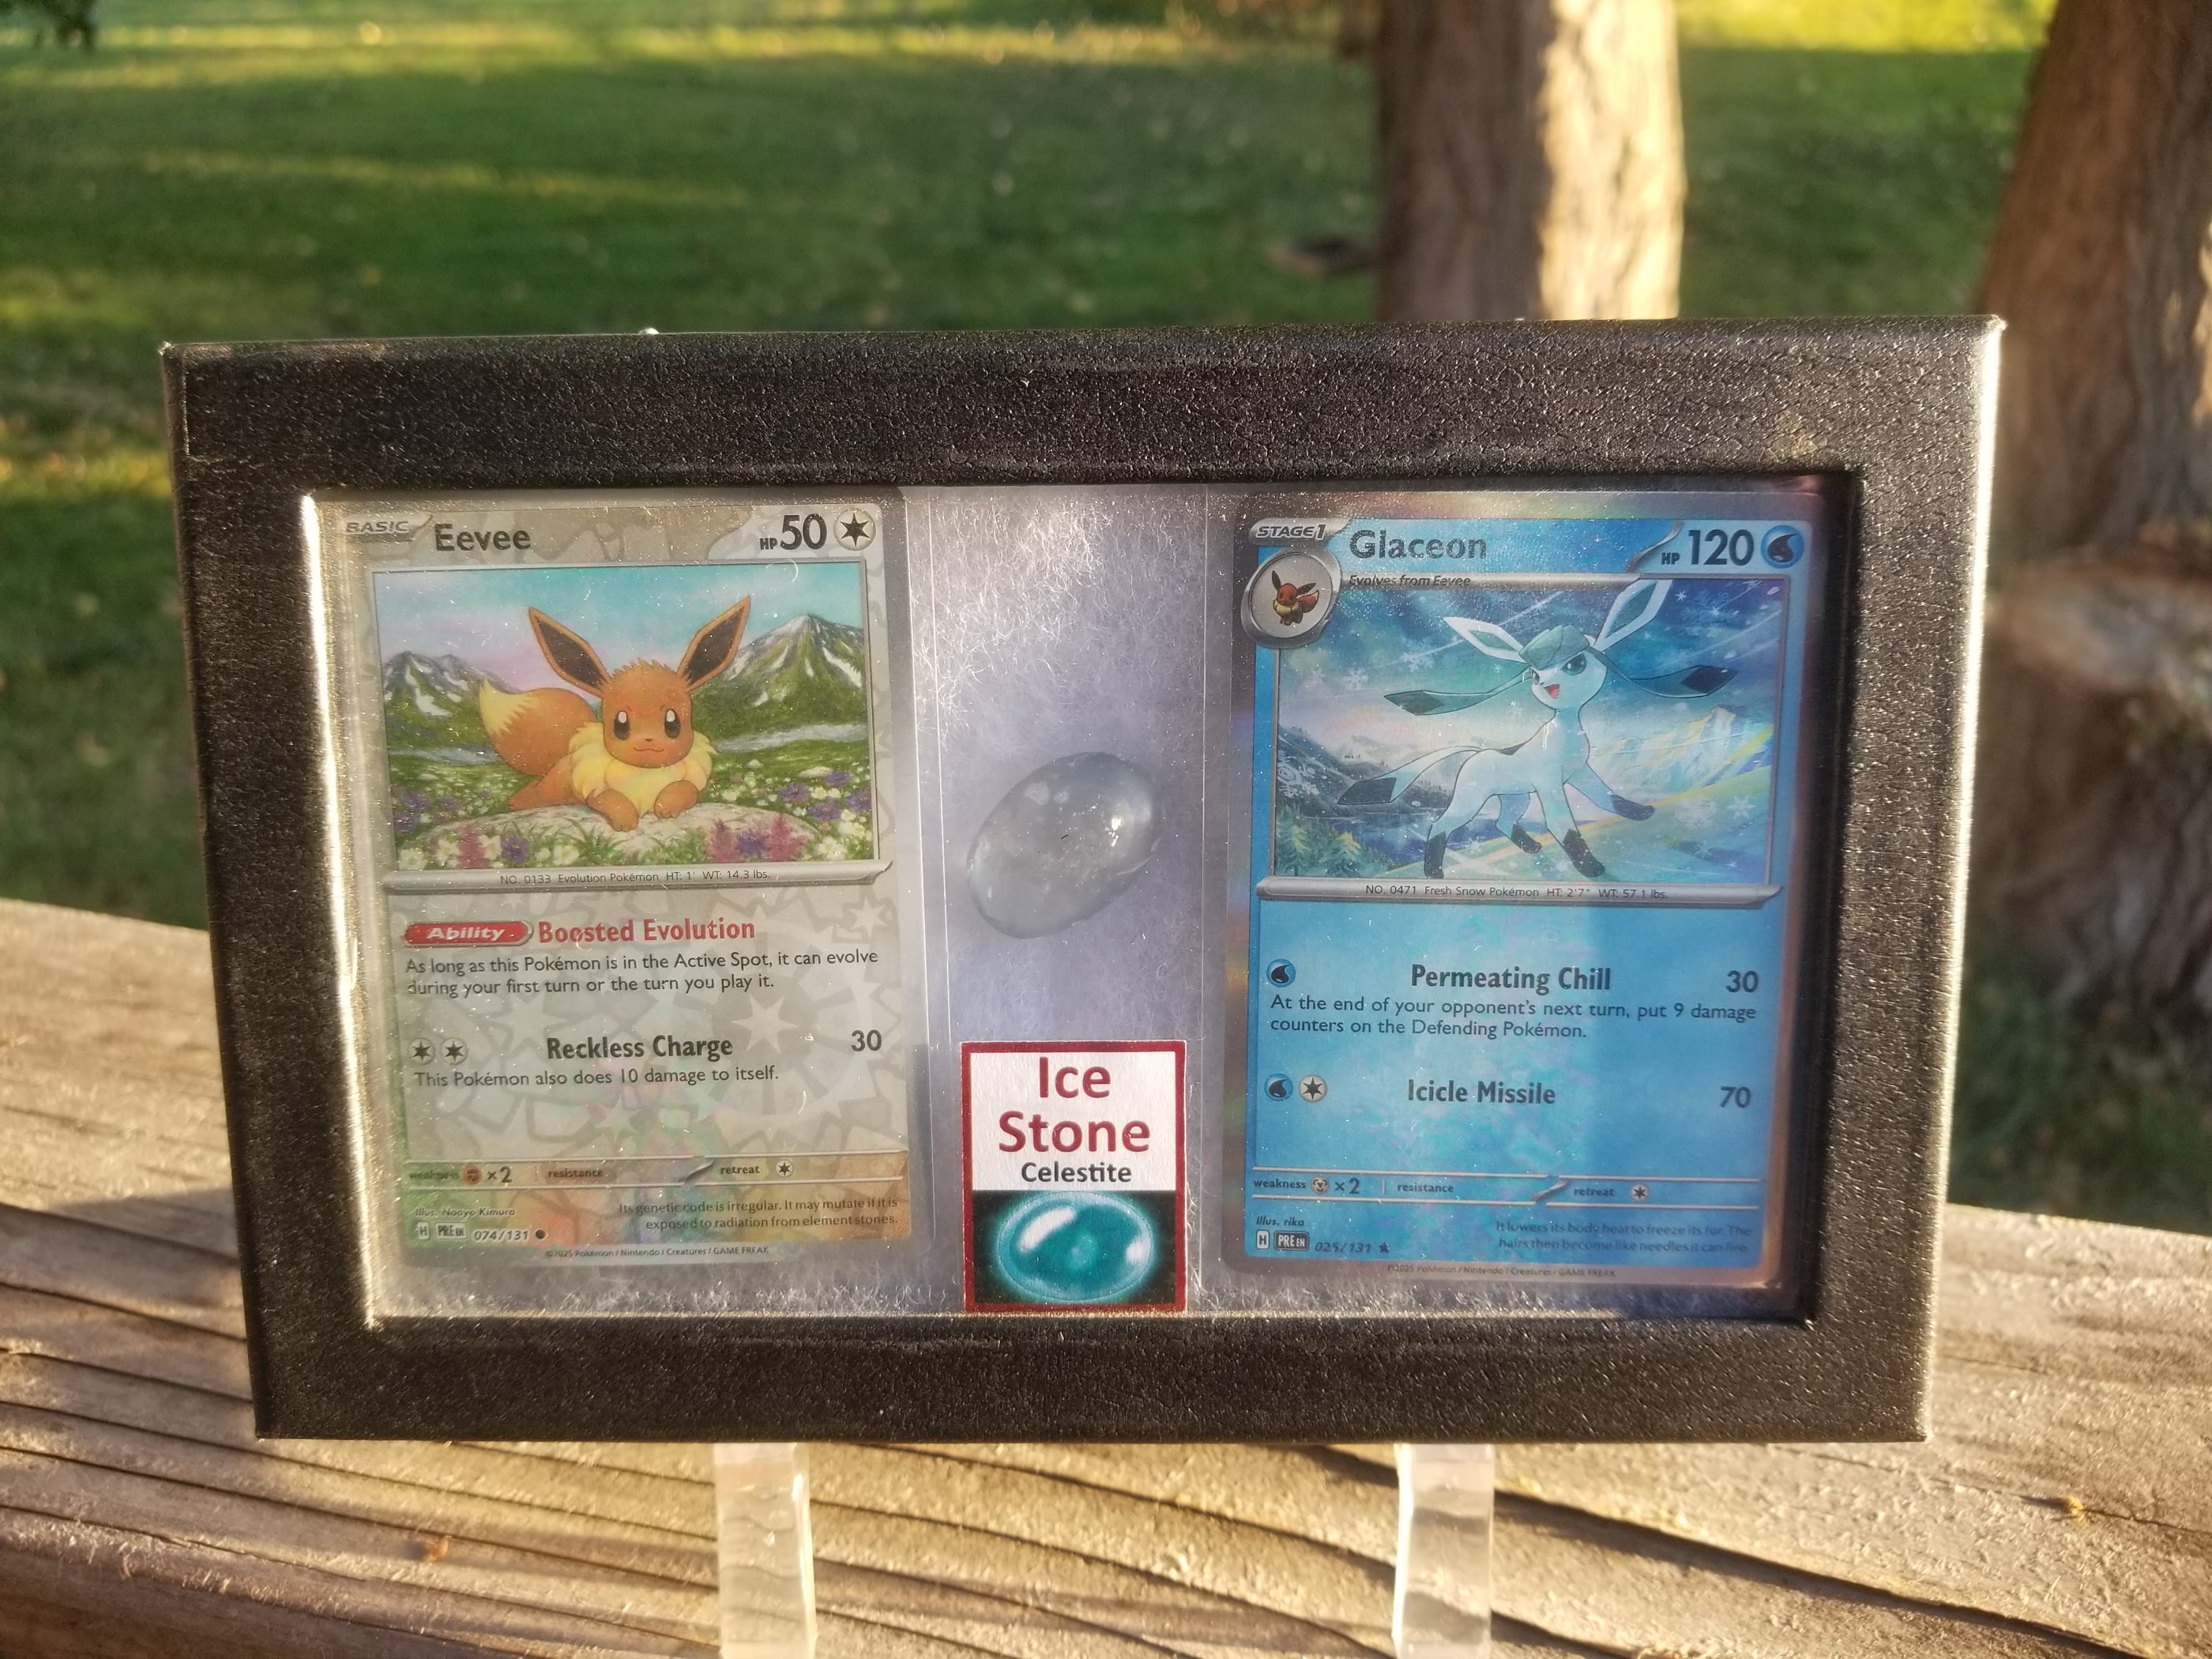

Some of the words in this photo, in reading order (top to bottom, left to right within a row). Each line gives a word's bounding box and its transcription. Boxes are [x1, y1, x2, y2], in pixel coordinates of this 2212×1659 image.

[346, 521, 409, 534] BASIC
[434, 524, 531, 551] Eevee
[759, 538, 778, 551] HP
[781, 514, 827, 551] 50
[1349, 529, 1486, 559] Glaceon
[1661, 552, 1680, 566] HP
[1687, 529, 1755, 566] 120
[1349, 574, 1397, 586] Evolves
[1399, 574, 1430, 587] from
[1432, 576, 1471, 587] Eevee
[500, 875, 520, 885] NO.
[525, 875, 552, 884] 0133
[558, 873, 607, 883] Evolution
[610, 871, 660, 882] Pokémon
[665, 872, 683, 882] HT:
[702, 871, 723, 881] WT:
[726, 870, 750, 880] 14.3
[753, 870, 771, 879] lbs.
[1365, 885, 1386, 894] NO.
[1390, 885, 1416, 894] 0471
[1424, 886, 1452, 896] Fresh
[1455, 886, 1486, 896] Snow
[1489, 886, 1540, 897] Pokémon
[1546, 888, 1563, 897] HT:
[1598, 889, 1620, 898] WT:
[1622, 889, 1646, 898] 57.1
[1650, 889, 1668, 899] lbs.
[427, 927, 506, 942] Ability
[538, 920, 634, 943] Boosted
[644, 917, 755, 941] Evolution
[406, 958, 426, 973] As
[431, 957, 465, 976] long
[469, 961, 485, 972] as
[490, 957, 519, 972] this
[525, 956, 601, 972] Pokémon
[606, 956, 618, 970] is
[623, 955, 637, 969] in
[642, 954, 669, 969] the
[674, 953, 726, 968] Active
[731, 952, 773, 970] Spot,
[778, 951, 789, 965] it
[794, 954, 821, 965] can
[826, 949, 878, 964] evolve
[408, 980, 458, 999] during
[463, 982, 501, 998] your
[506, 978, 543, 993] first
[544, 979, 580, 992] turn
[586, 980, 607, 991] or
[611, 976, 638, 991] the
[643, 976, 679, 990] turn
[685, 977, 715, 993] you
[721, 974, 753, 992] play
[758, 973, 774, 988] it.
[1411, 964, 1550, 996] Permeating
[1558, 966, 1611, 991] Chill
[1725, 969, 1759, 994] 30
[1270, 994, 1292, 1010] At
[1299, 995, 1326, 1010] the
[1334, 995, 1364, 1011] end
[1371, 996, 1390, 1012] of
[1394, 1001, 1435, 1016] your
[1441, 999, 1536, 1018] opponent's
[1543, 1003, 1582, 1016] next
[1589, 1005, 1631, 1018] turn,
[1637, 1005, 1667, 1022] put
[1673, 1003, 1684, 1018] 9
[1691, 1003, 1757, 1024] damage
[1270, 1021, 1344, 1033] counters
[1350, 1021, 1371, 1033] on
[1378, 1018, 1405, 1034] the
[1412, 1019, 1497, 1039] Defending
[1503, 1021, 1587, 1038] Pokémon.
[547, 1036, 645, 1059] Reckless
[653, 1035, 733, 1063] Charge
[851, 1029, 882, 1051] 30
[415, 1071, 449, 1086] This
[454, 1070, 530, 1086] Pokémon
[536, 1070, 567, 1085] also
[574, 1069, 612, 1084] does
[621, 1068, 638, 1083] 10
[645, 1067, 705, 1086] damage
[711, 1068, 729, 1081] to
[735, 1064, 779, 1081] itself.
[1039, 1056, 1111, 1098] Ice
[1407, 1078, 1468, 1103] Icicle
[1477, 1079, 1556, 1104] Missile
[1717, 1085, 1751, 1108] 70
[999, 1111, 1151, 1153] Stone
[547, 1167, 604, 1179] resistance
[720, 1164, 760, 1175] retreat
[1021, 1161, 1132, 1183] Celestite
[1253, 1178, 1307, 1190] weakness
[1397, 1182, 1454, 1194] resistance
[1573, 1187, 1615, 1198] retreat
[479, 1207, 515, 1217] Kimura
[636, 1202, 682, 1217] genetic
[683, 1201, 713, 1213] code
[715, 1200, 725, 1212] is
[728, 1199, 782, 1214] irregular.
[784, 1199, 793, 1210] It
[796, 1200, 820, 1213] may
[822, 1198, 865, 1209] mutate
[867, 1197, 876, 1208] if
[878, 1197, 886, 1208] it
[888, 1196, 897, 1208] is
[645, 1217, 698, 1232] exposed
[700, 1218, 713, 1228] to
[715, 1217, 769, 1228] radiation
[771, 1215, 800, 1227] from
[803, 1215, 852, 1226] element
[855, 1214, 898, 1225] stones.
[1283, 1216, 1304, 1227] rika
[474, 1229, 529, 1240] 074/131
[1258, 1233, 1267, 1246] H
[1277, 1233, 1296, 1247] PRE
[1315, 1241, 1372, 1254] 025/131
[620, 1248, 660, 1258] Nintendo
[667, 1247, 706, 1256] Creatures
[713, 1247, 739, 1255] GAME
[742, 1246, 769, 1255] FREAK
